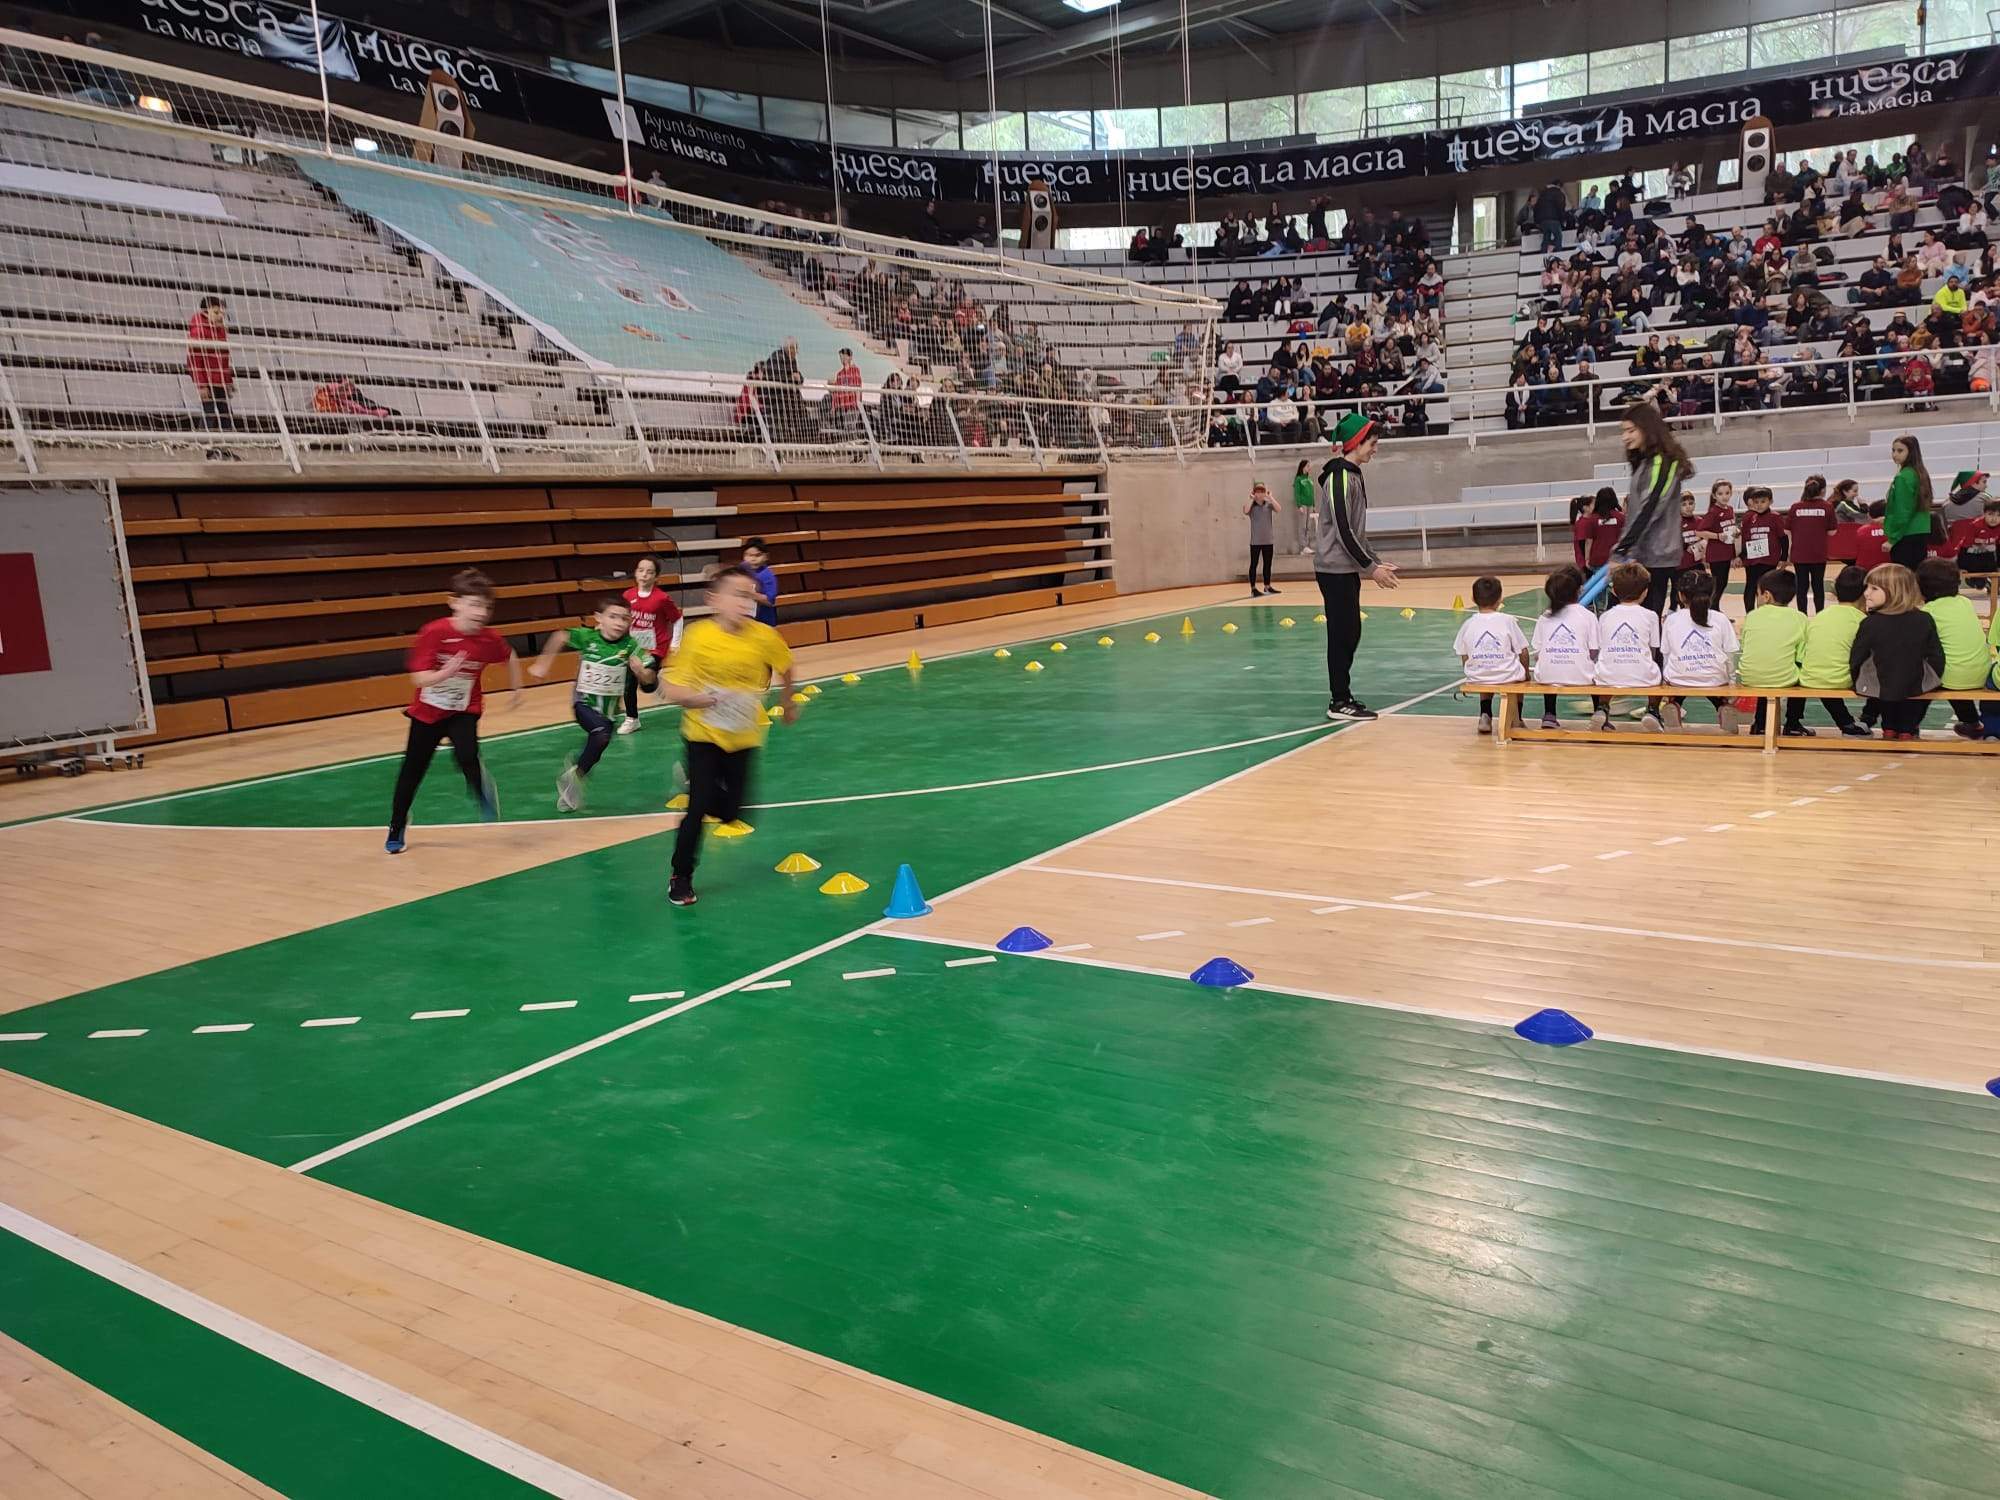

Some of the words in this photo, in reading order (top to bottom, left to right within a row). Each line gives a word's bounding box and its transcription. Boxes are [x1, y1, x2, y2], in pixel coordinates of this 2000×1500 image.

[644, 109, 746, 150] Ayuntamiento
[650, 133, 669, 151] de
[670, 137, 728, 166] Huesca
